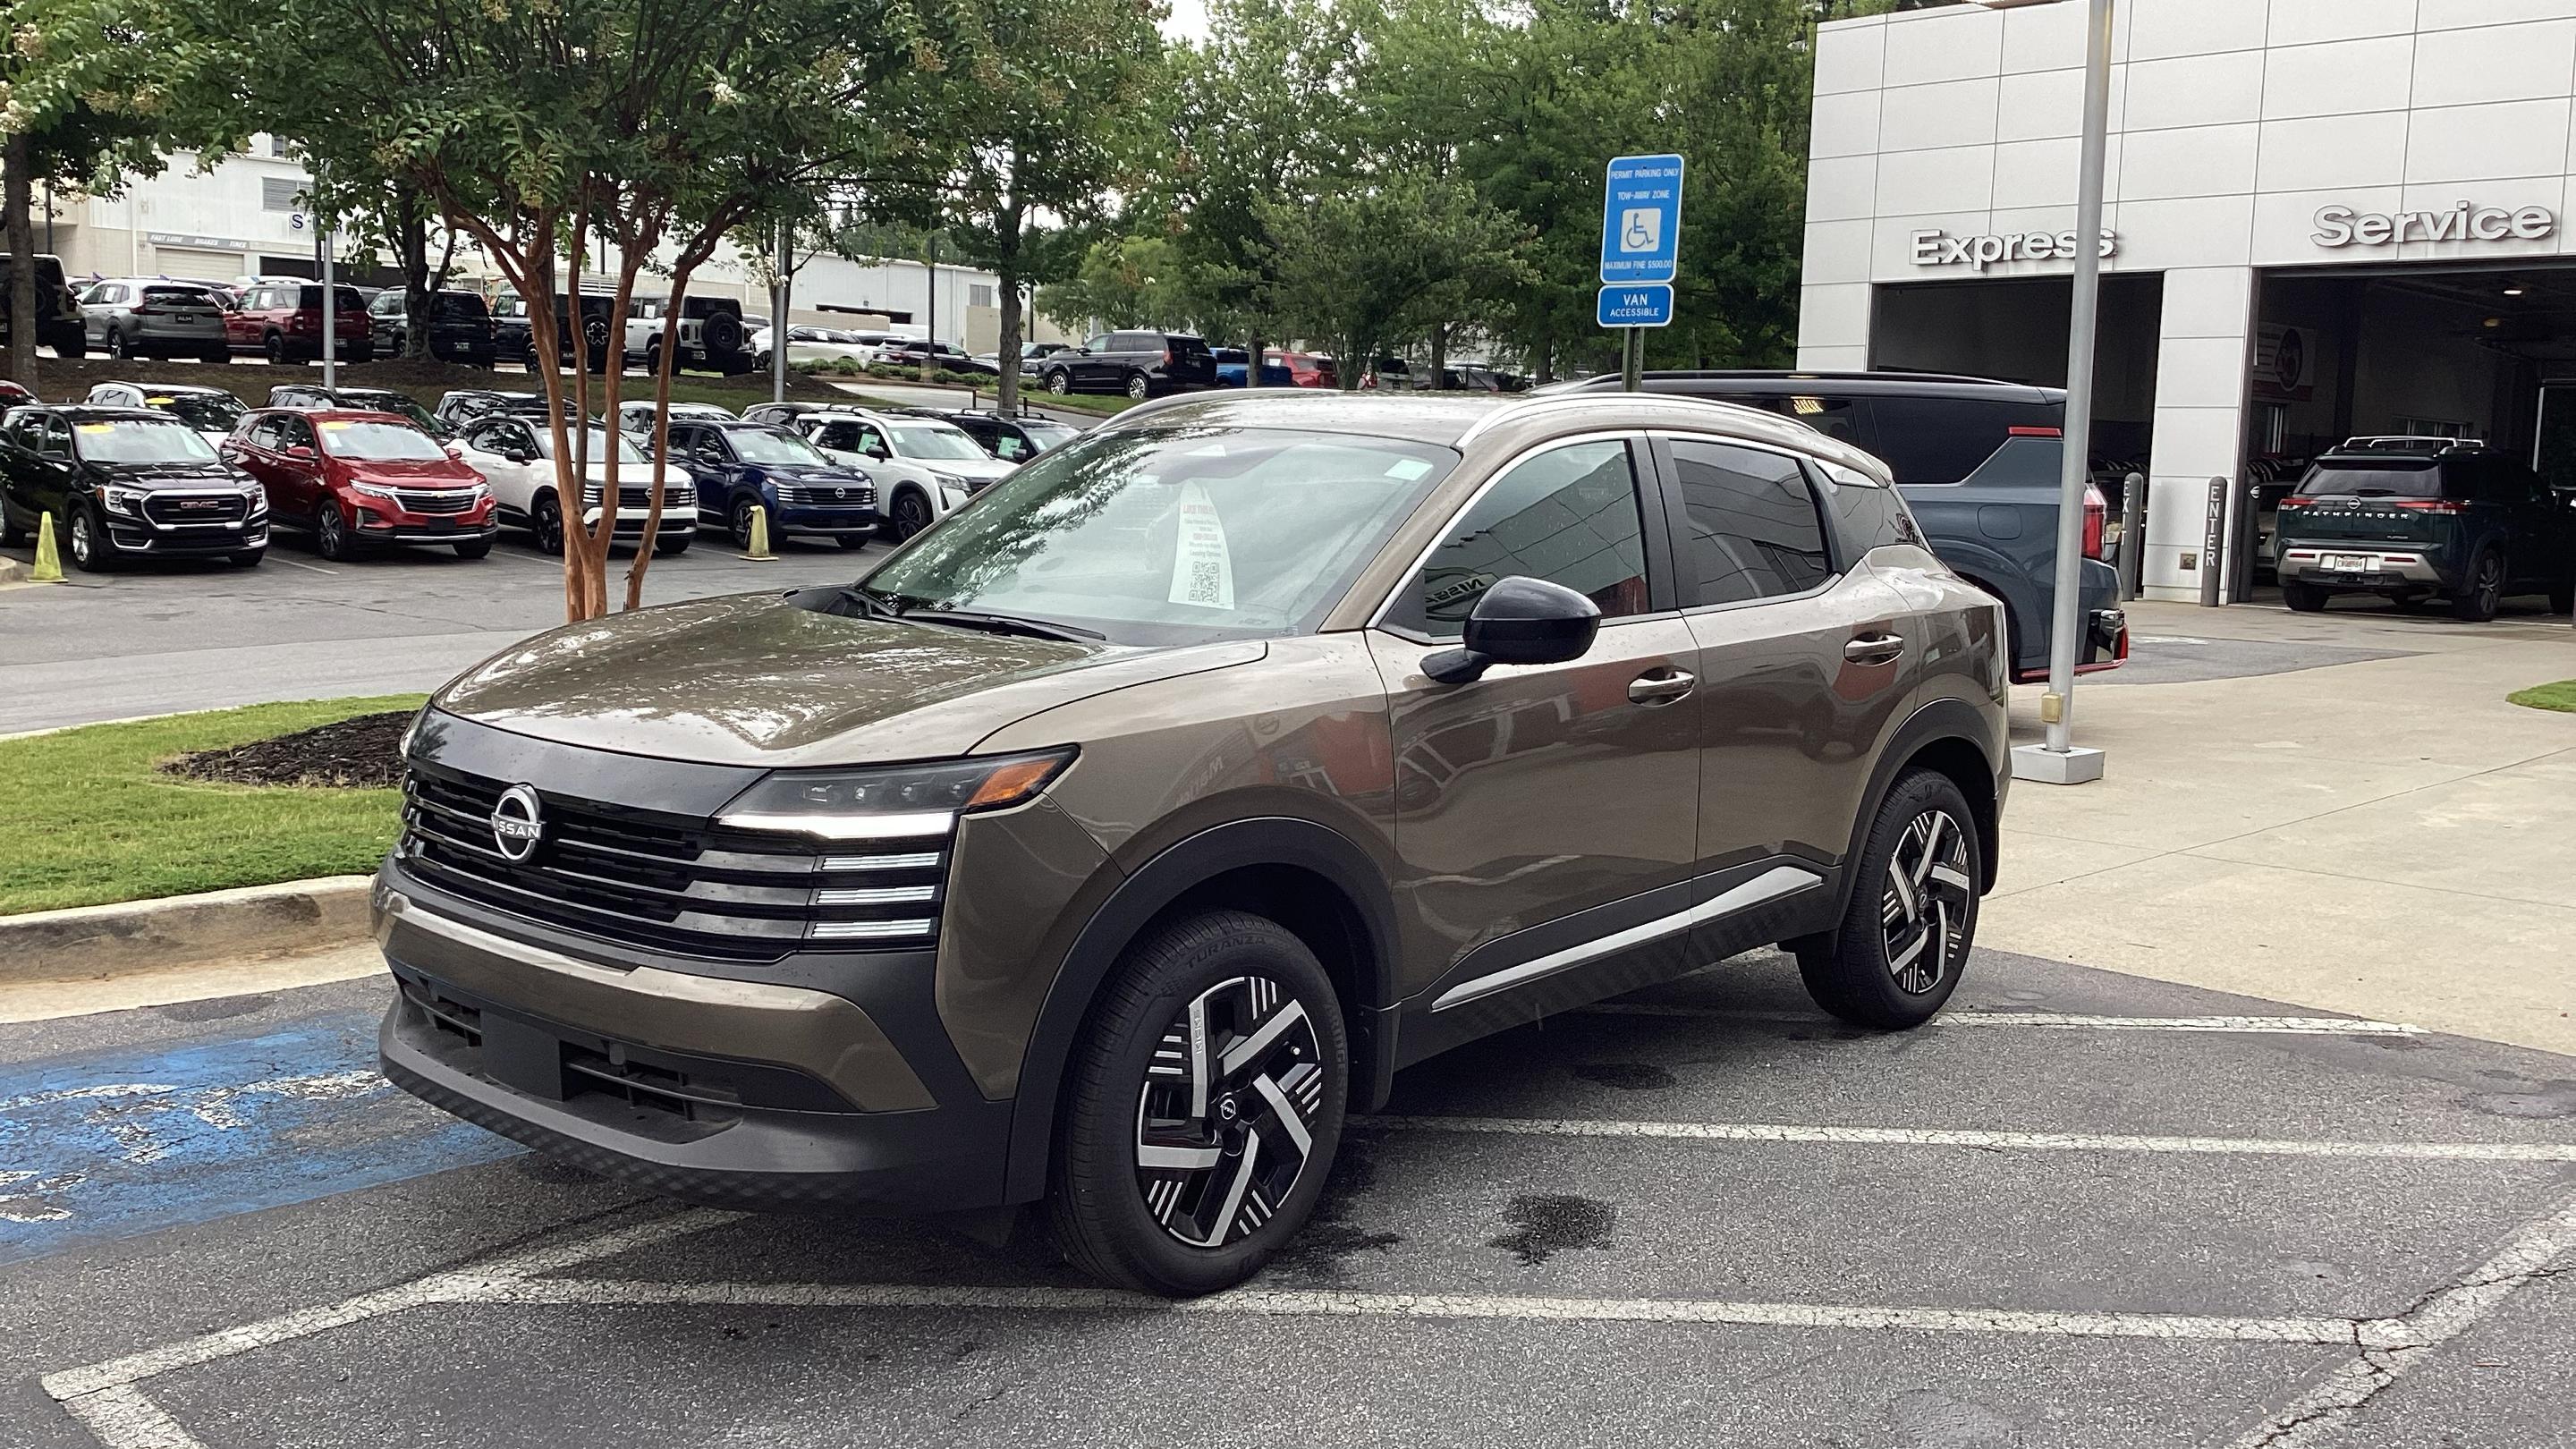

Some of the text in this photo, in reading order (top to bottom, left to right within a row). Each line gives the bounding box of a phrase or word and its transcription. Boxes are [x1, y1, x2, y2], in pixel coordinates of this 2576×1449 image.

[1611, 167, 1680, 179] PERMIT PARKING ONLY
[1617, 190, 1670, 201] TOW-AWAY ZONE
[2309, 200, 2554, 247] Service
[1909, 227, 2118, 271] Express
[1605, 260, 1631, 269] MAXIMUM
[1633, 260, 1646, 268] FINE
[1623, 293, 1648, 306] VAN
[1610, 308, 1659, 318] ACCESSIBLE
[181, 501, 219, 509] GMC
[2121, 481, 2131, 546] EXIT
[2302, 511, 2410, 520] PATHFINDER
[2206, 486, 2220, 566] ENTER
[1188, 936, 1267, 968] TURANZA
